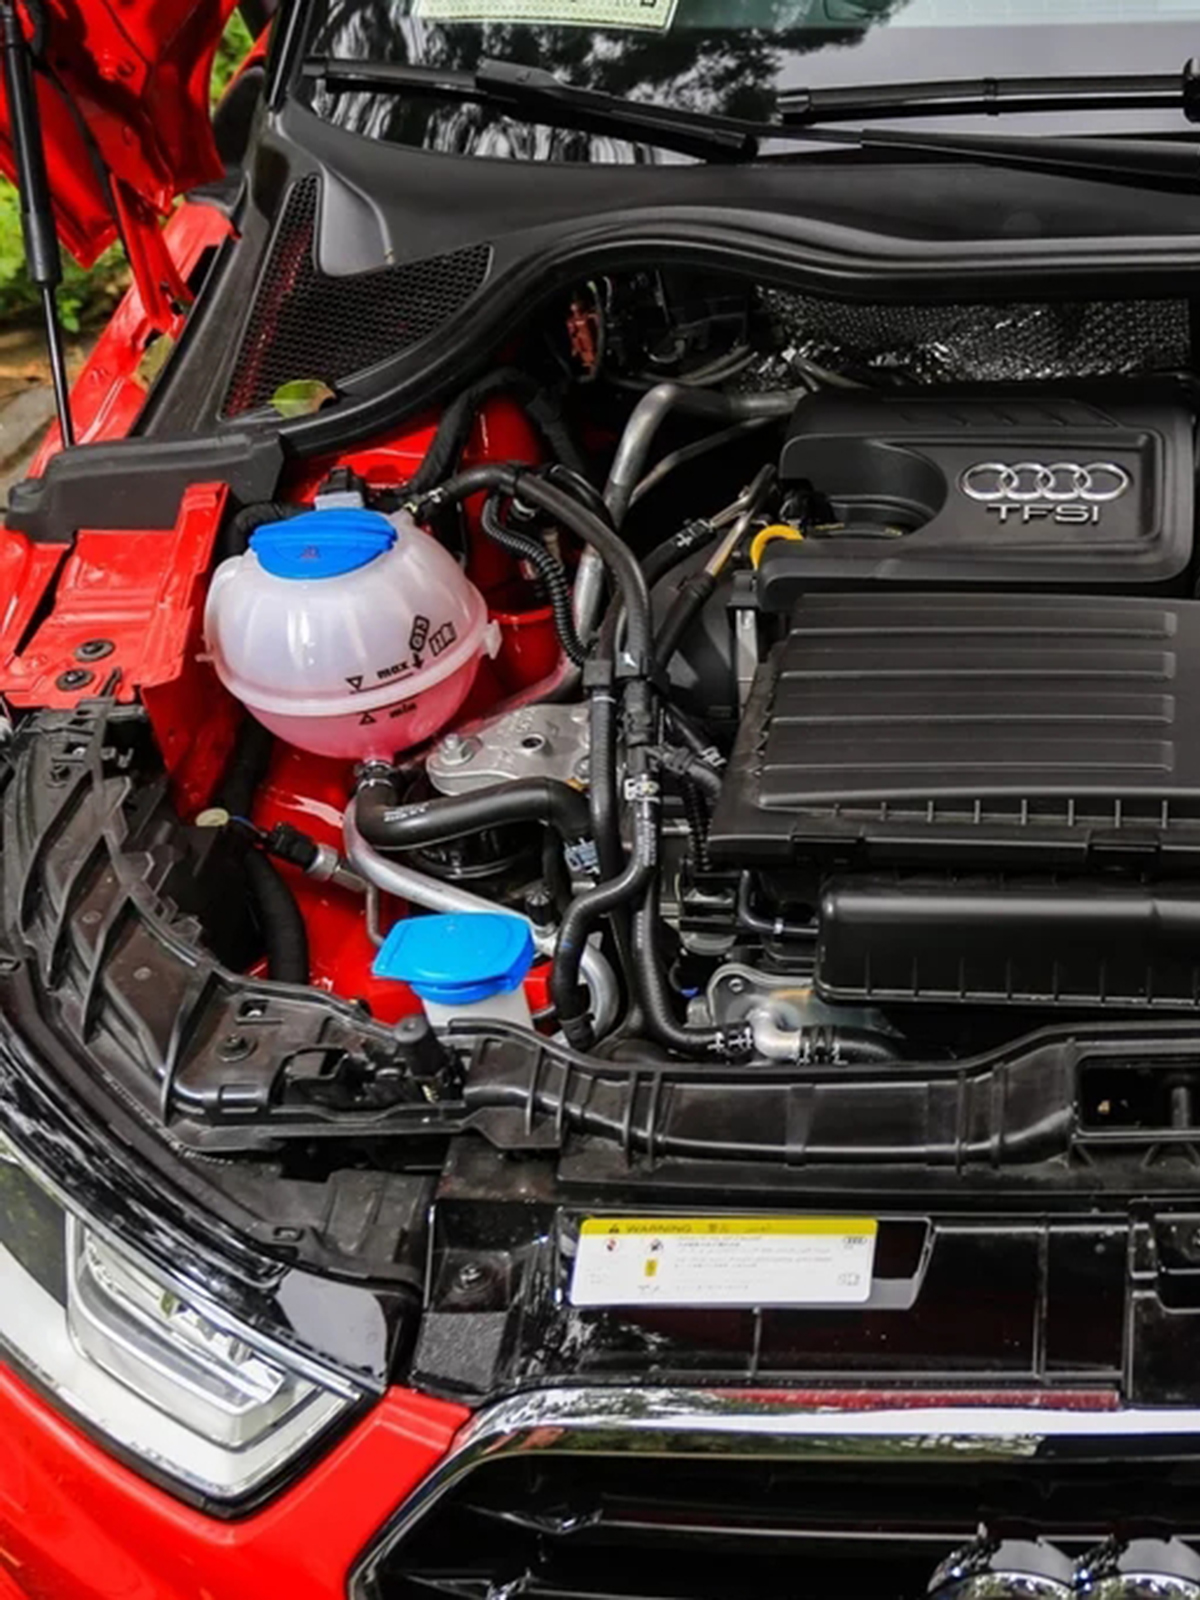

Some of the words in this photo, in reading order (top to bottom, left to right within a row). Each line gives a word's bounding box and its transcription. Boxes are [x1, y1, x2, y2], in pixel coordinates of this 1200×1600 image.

[987, 502, 1099, 523] TFSI
[377, 660, 410, 679] max
[626, 1224, 692, 1233] WARNING
